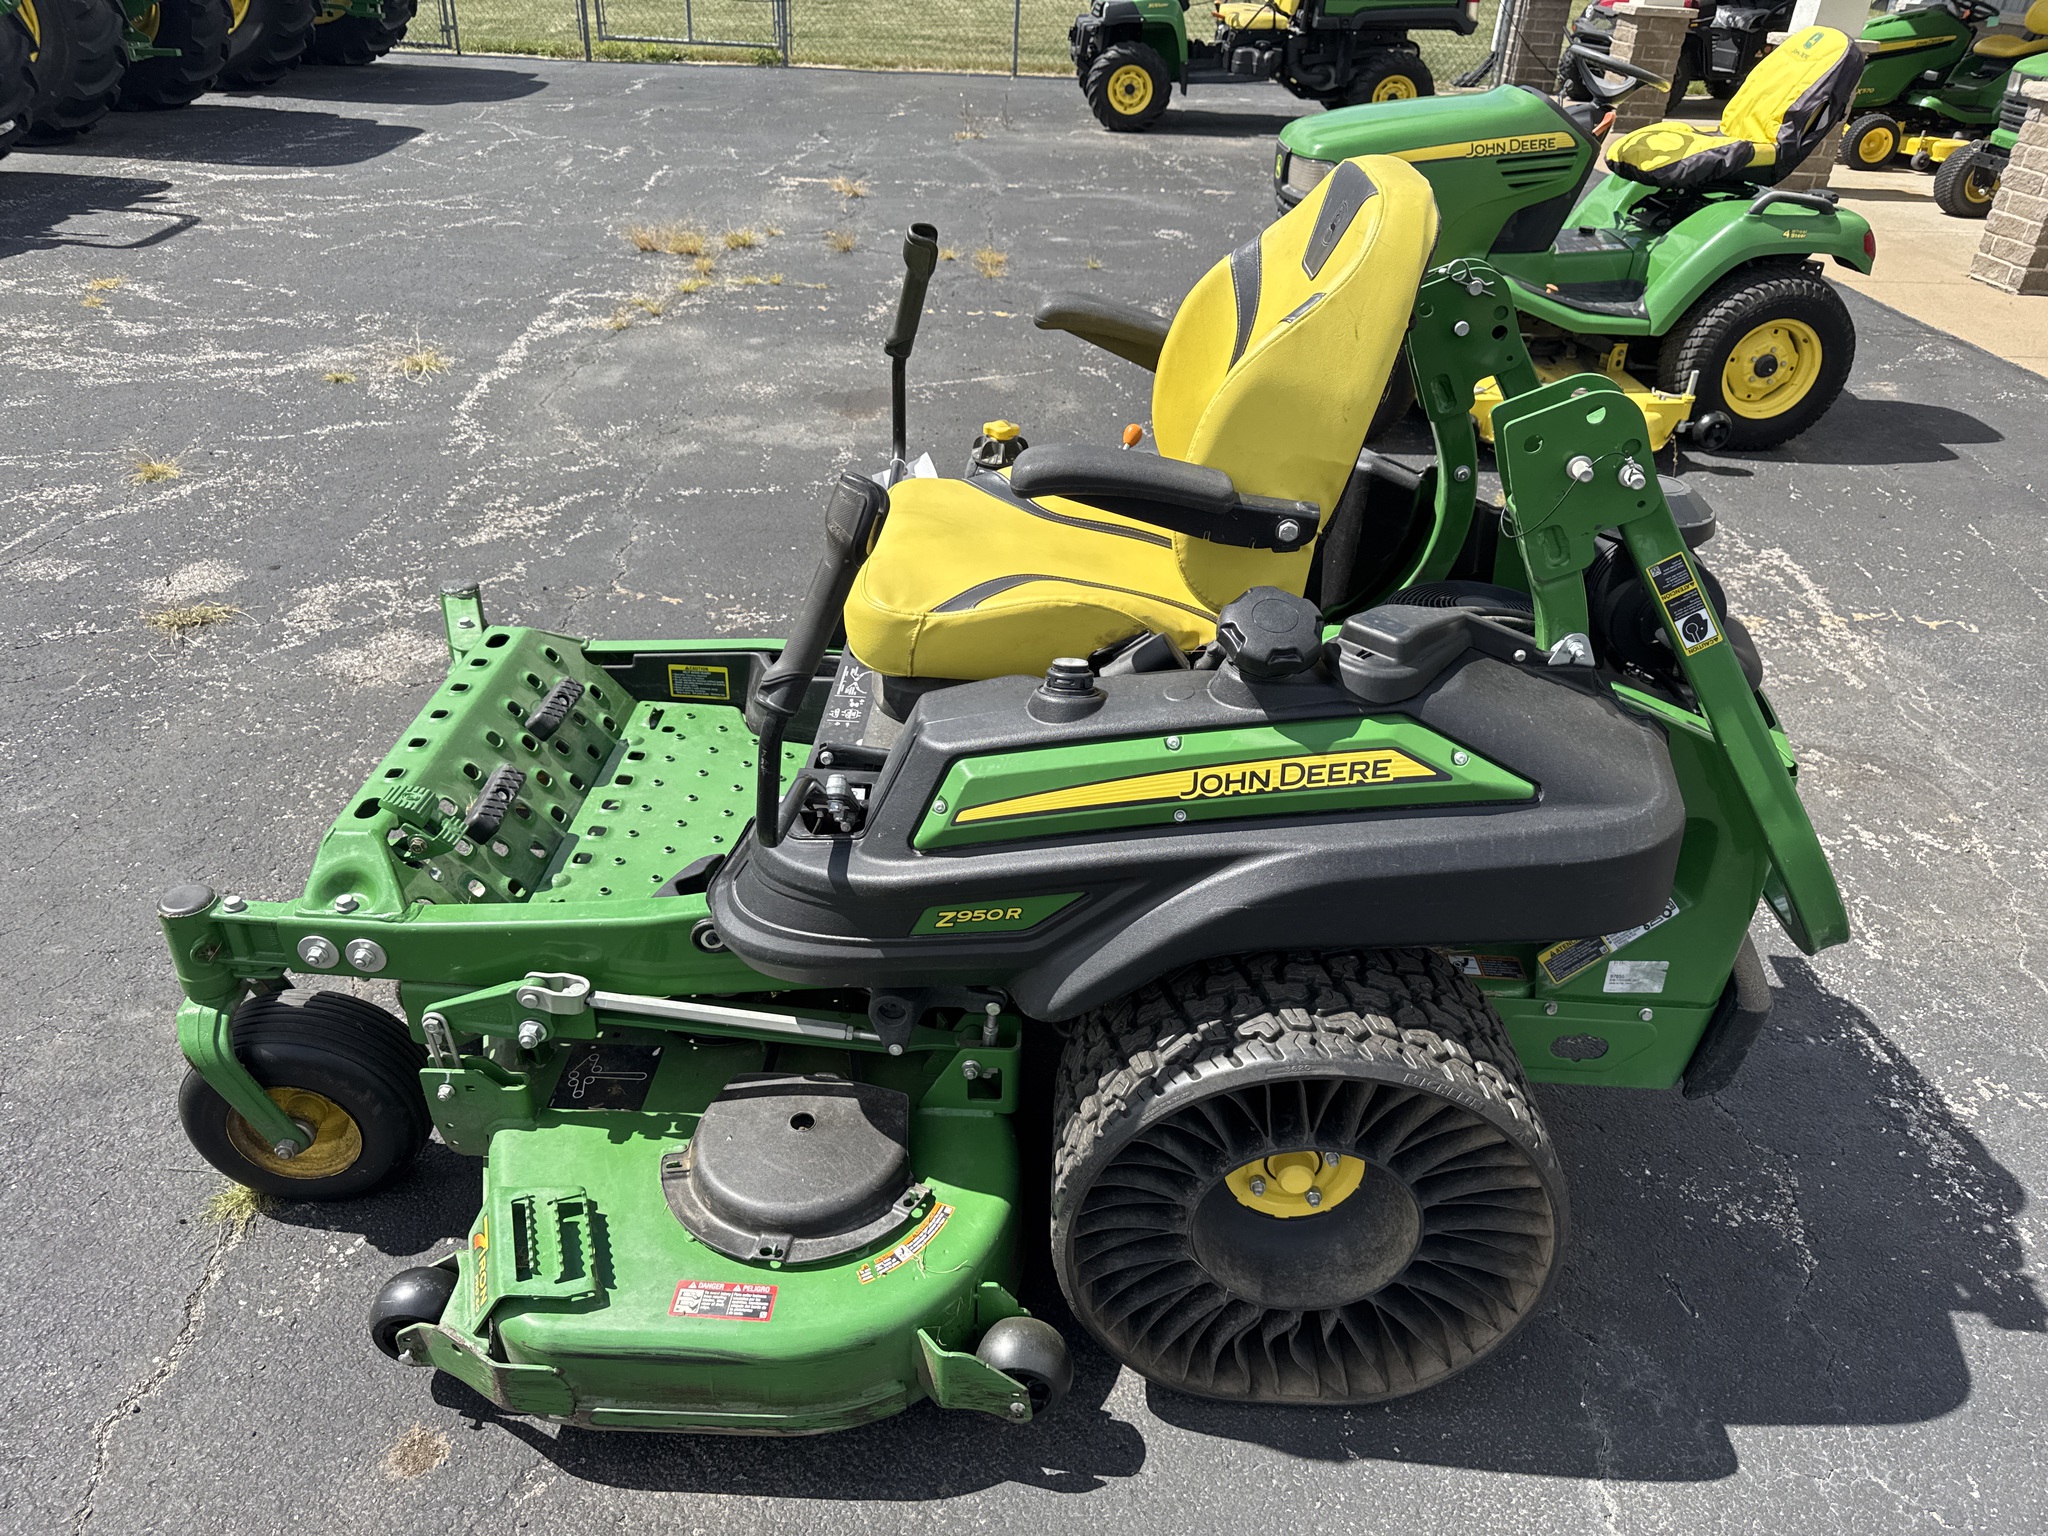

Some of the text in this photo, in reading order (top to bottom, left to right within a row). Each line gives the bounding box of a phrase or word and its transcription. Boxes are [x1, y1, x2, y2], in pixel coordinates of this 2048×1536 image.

[1466, 137, 1556, 158] JOHN DEERE
[1782, 229, 1790, 239] 4
[1688, 638, 1714, 655] CAUTION
[1181, 758, 1392, 797] JOHN DEERE
[1403, 1073, 1486, 1112] MICHELIN
[698, 1282, 771, 1294] DANGER PELIGRO
